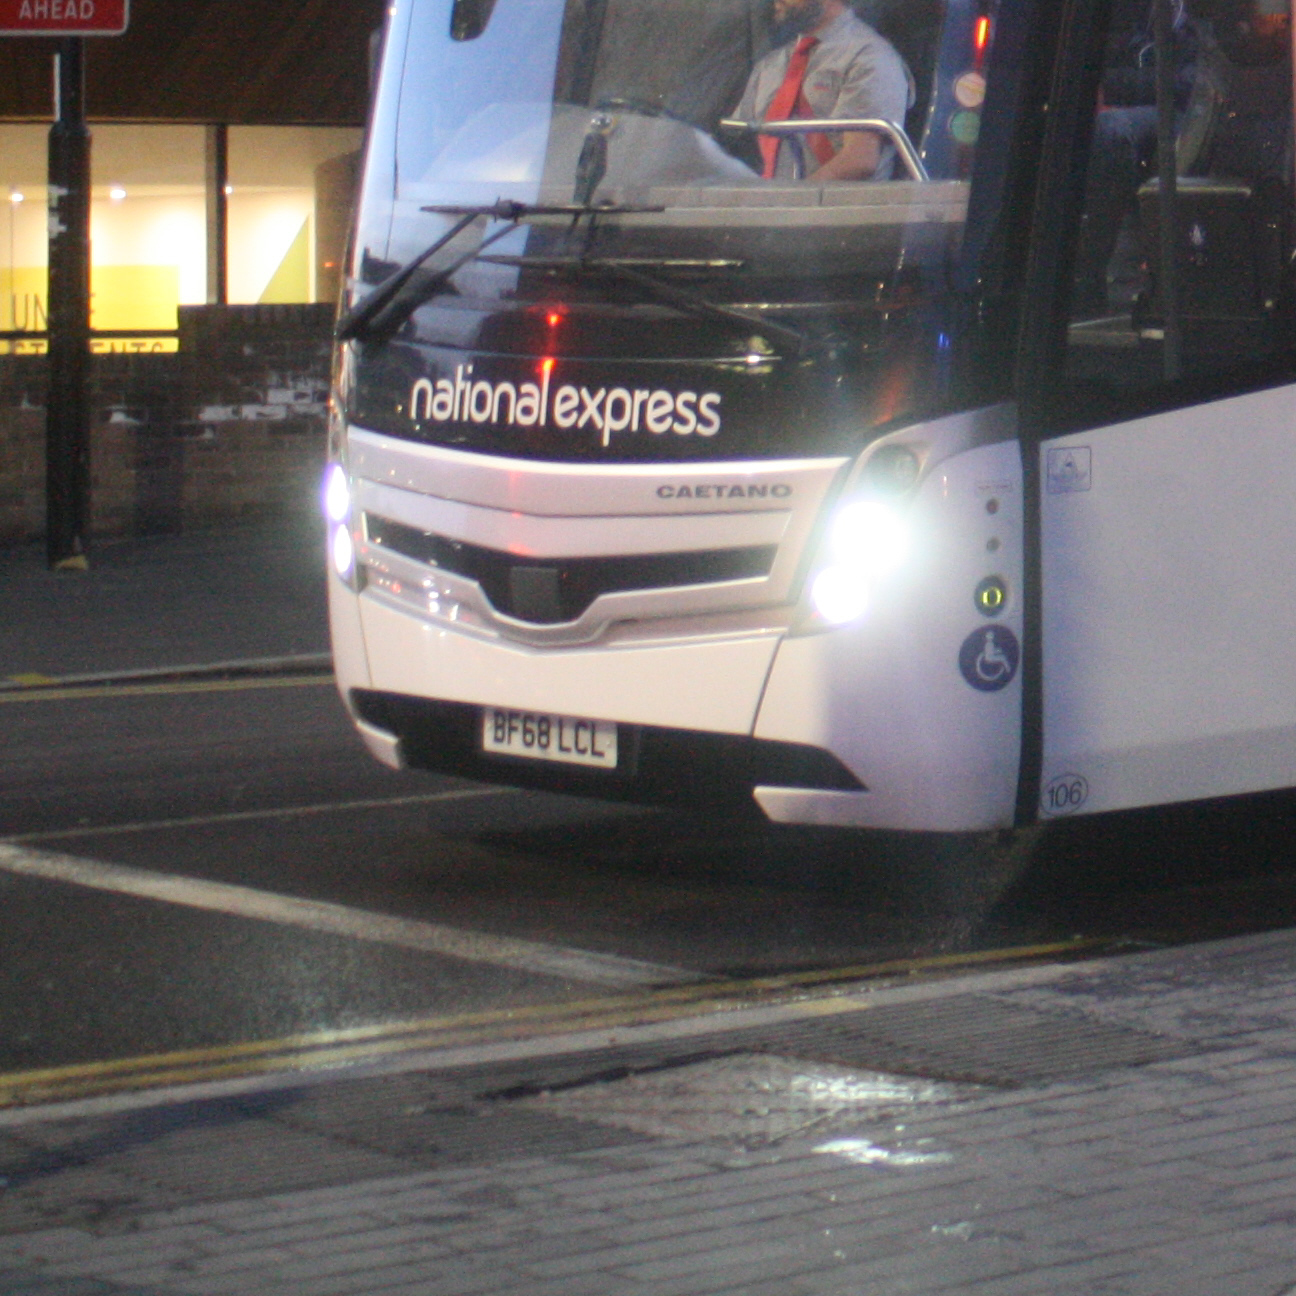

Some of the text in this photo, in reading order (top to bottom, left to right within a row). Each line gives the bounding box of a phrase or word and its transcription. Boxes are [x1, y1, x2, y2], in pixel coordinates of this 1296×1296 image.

[410, 364, 722, 447] national express
[656, 483, 793, 500] CAETANO
[493, 711, 605, 758] BF68 LCL
[1047, 781, 1083, 808] 106
